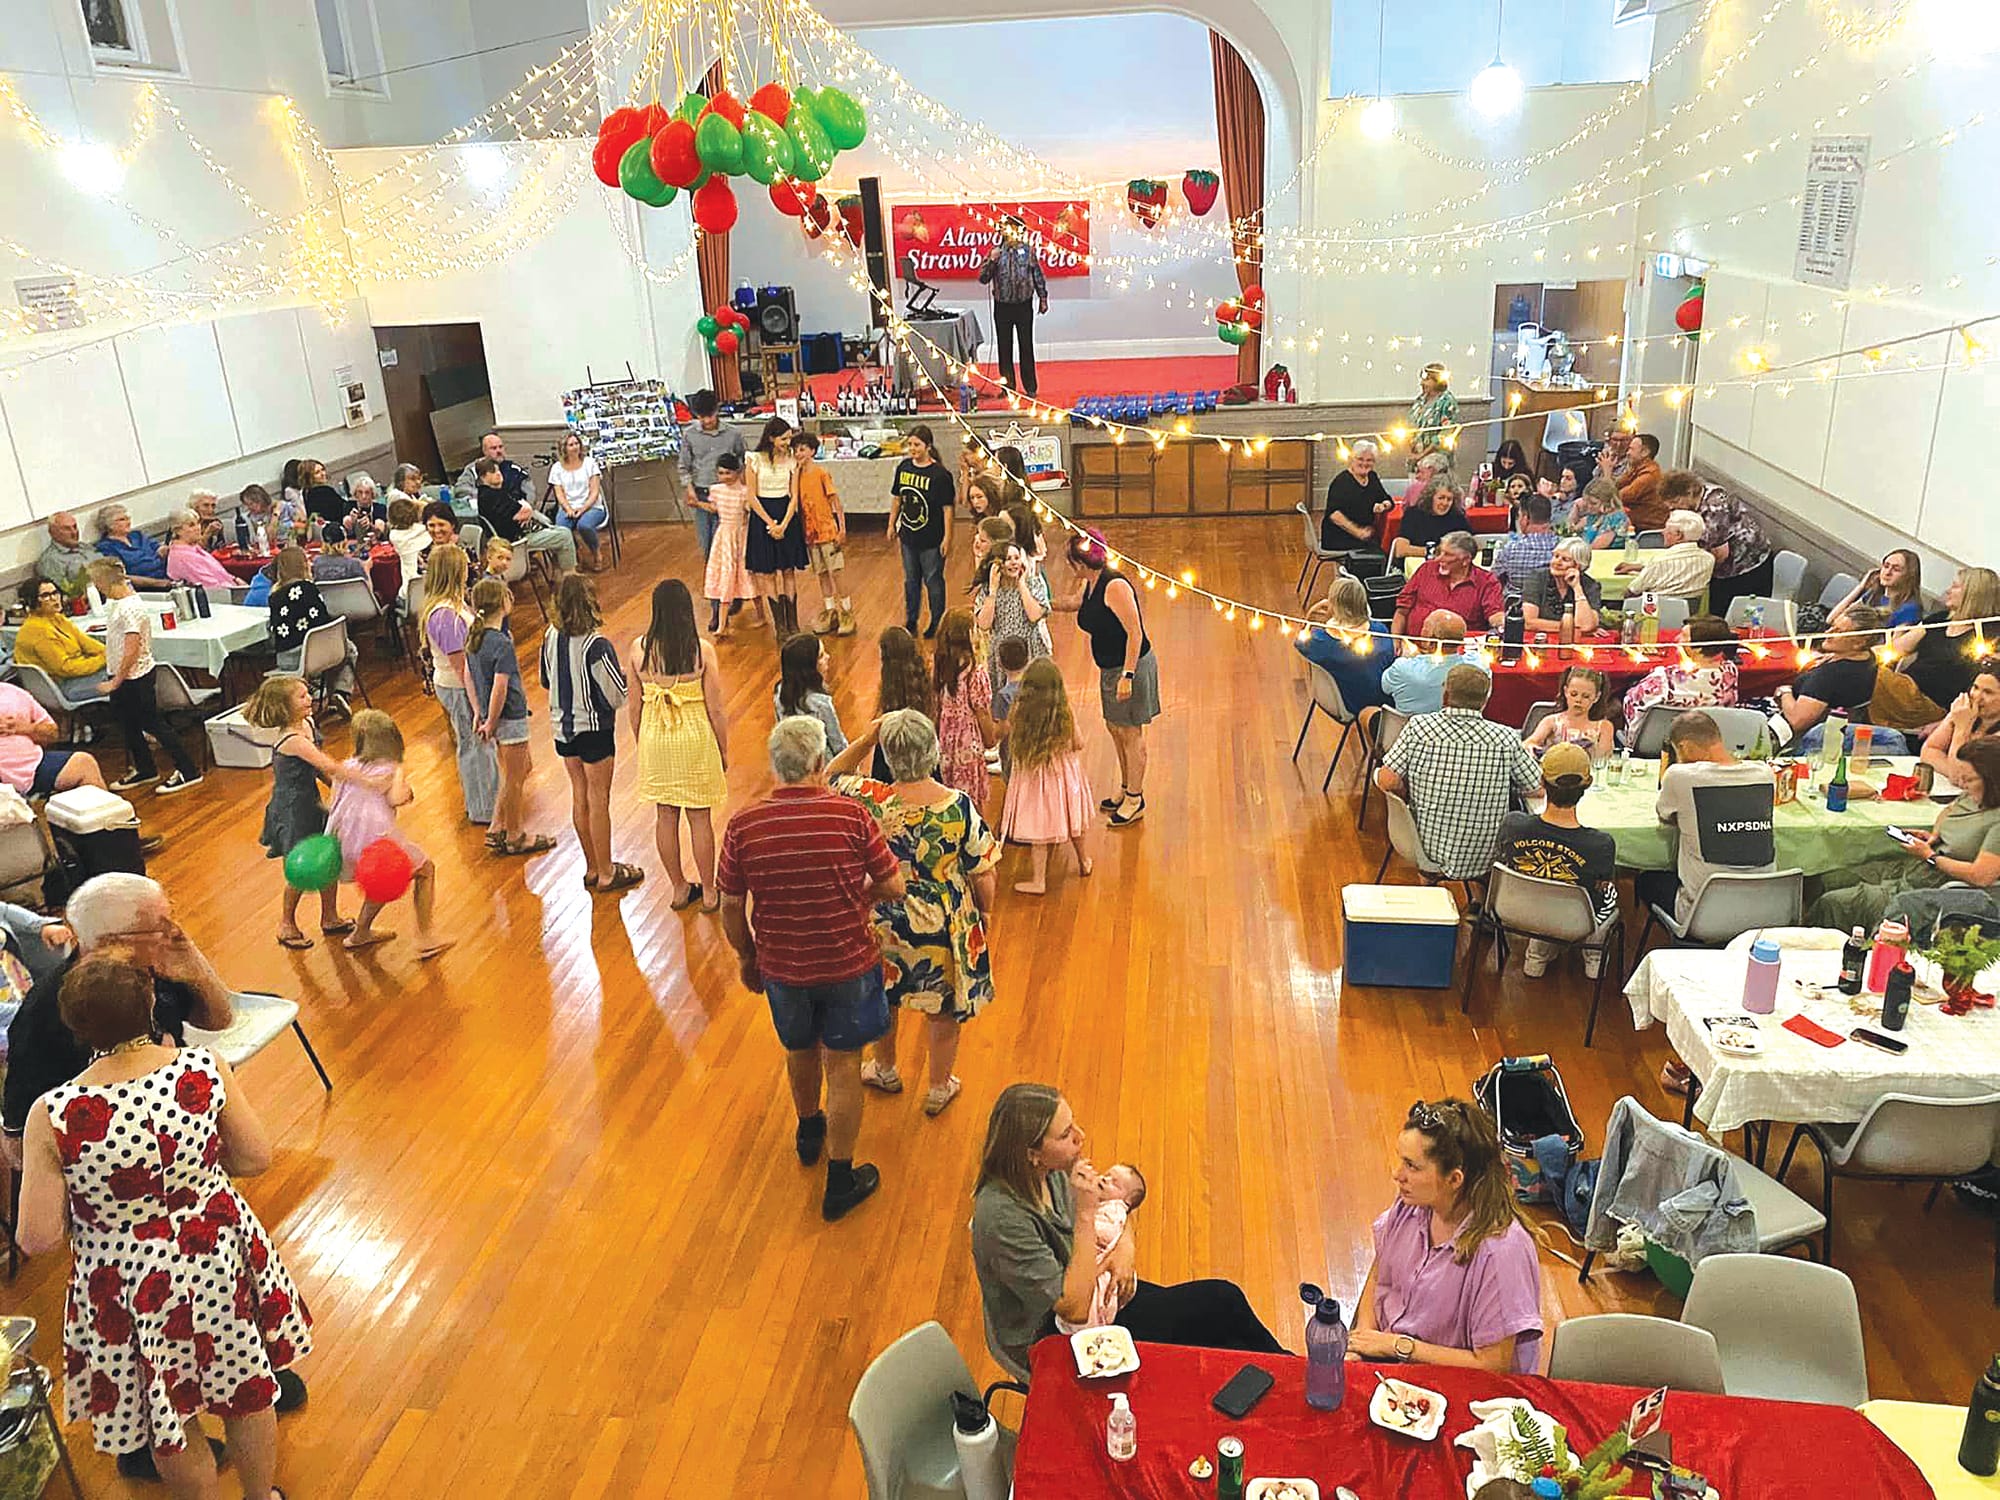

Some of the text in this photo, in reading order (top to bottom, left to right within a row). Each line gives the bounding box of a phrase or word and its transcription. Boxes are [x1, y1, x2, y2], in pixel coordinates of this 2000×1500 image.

[1513, 839, 1586, 867] VOLCOM STONE
[1637, 1389, 1664, 1415] 13
